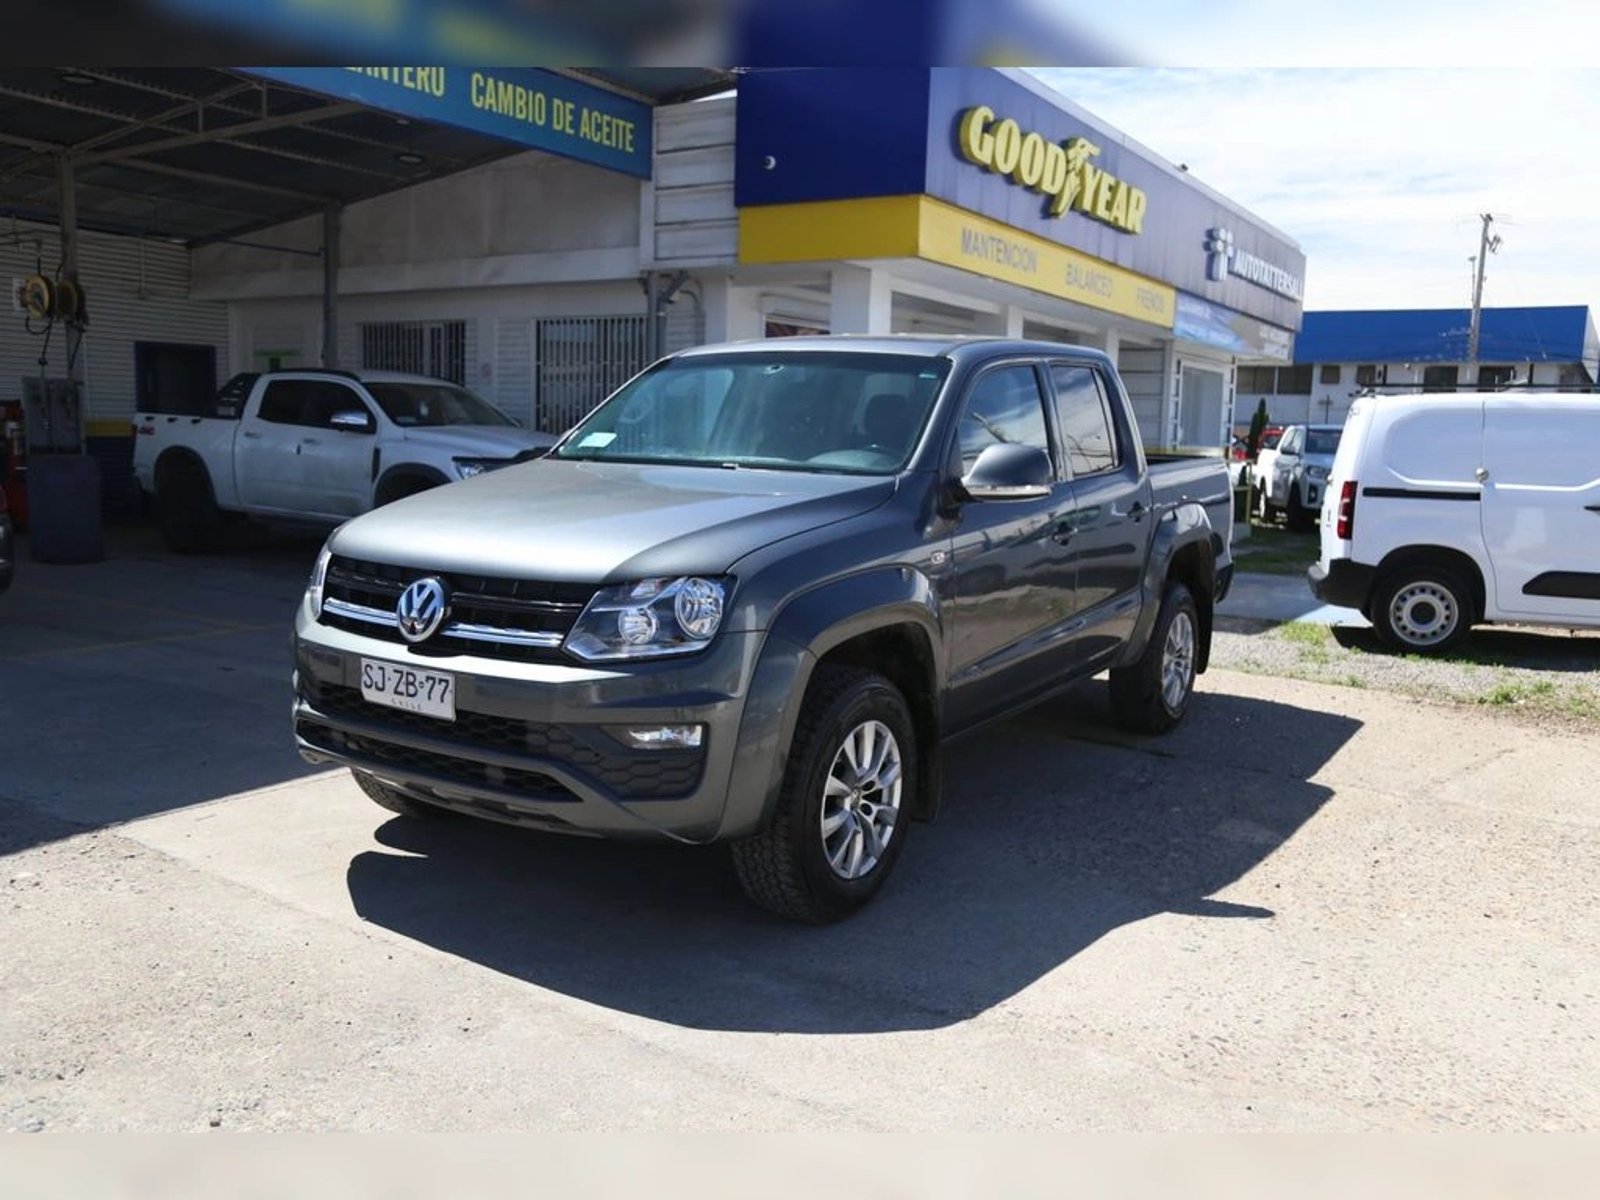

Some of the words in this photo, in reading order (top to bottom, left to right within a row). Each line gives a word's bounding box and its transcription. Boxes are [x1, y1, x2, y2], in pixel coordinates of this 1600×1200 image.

[471, 72, 546, 125] CAMBIO
[552, 98, 575, 135] DE
[579, 108, 634, 153] ACEITE
[961, 228, 1037, 273] MANTENCION
